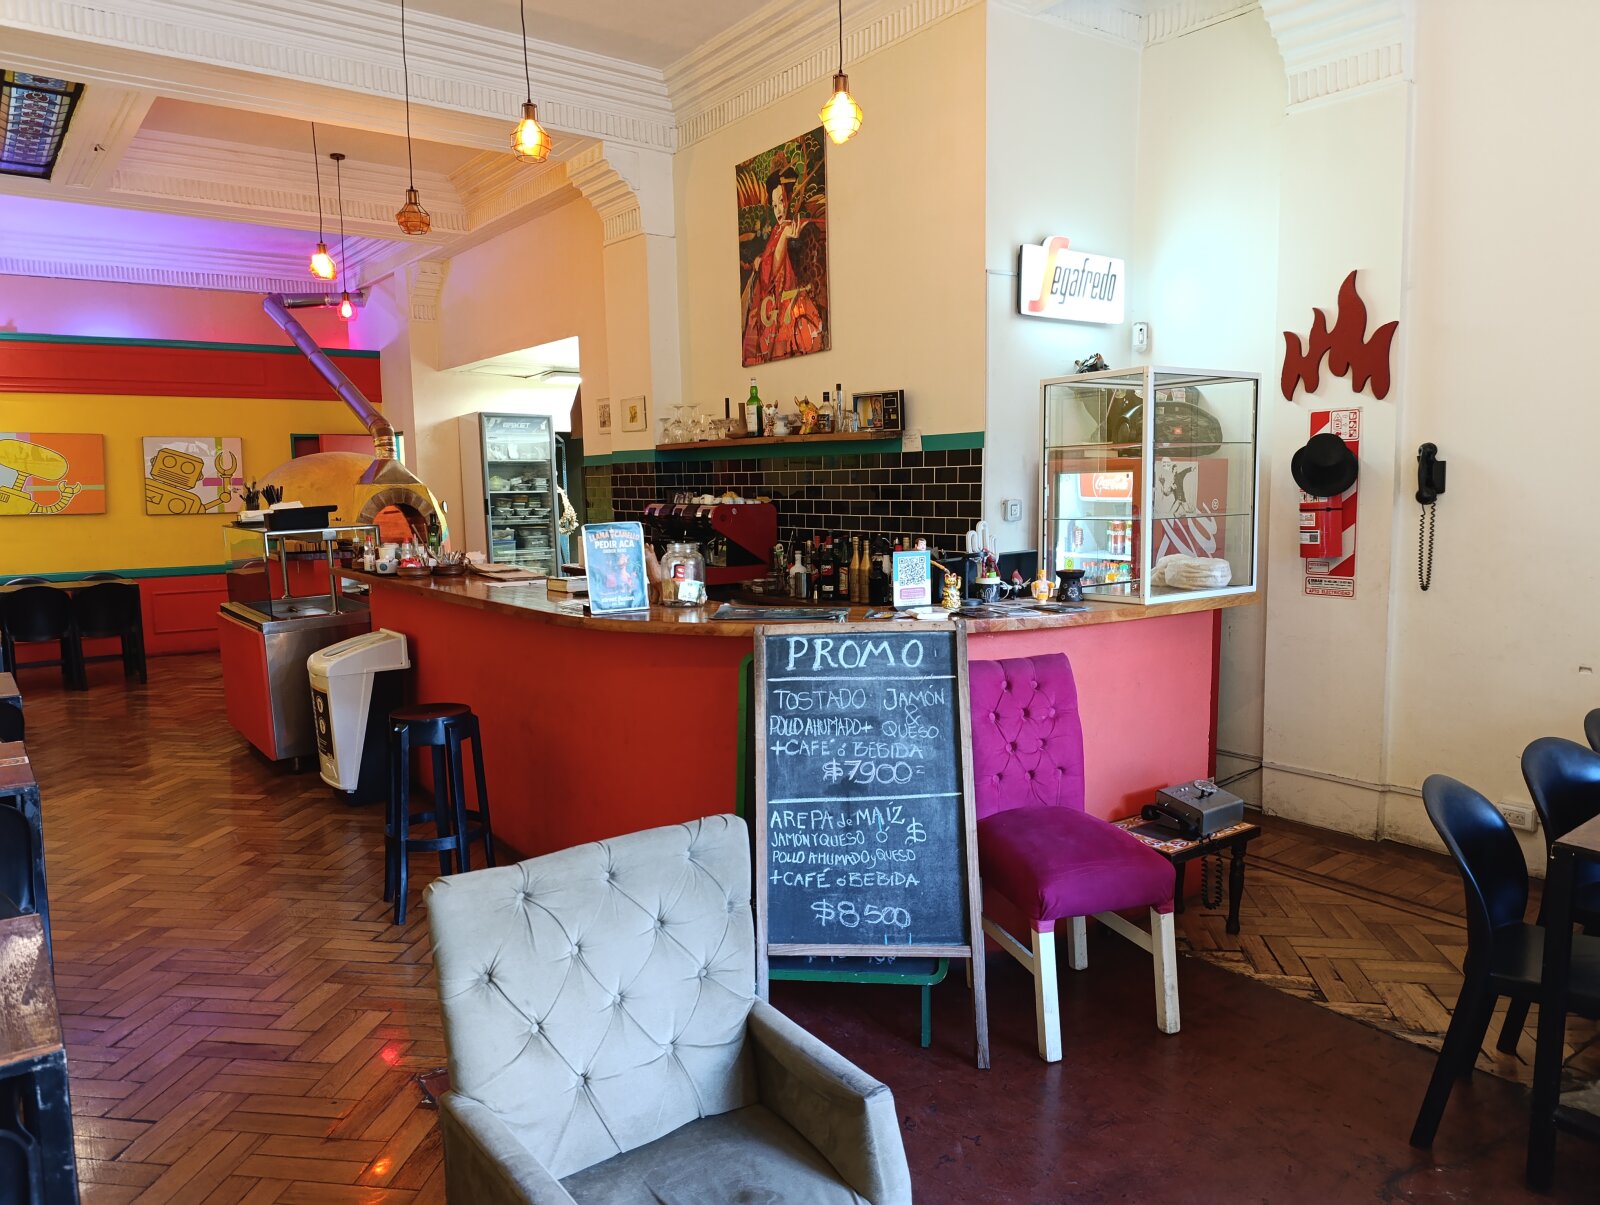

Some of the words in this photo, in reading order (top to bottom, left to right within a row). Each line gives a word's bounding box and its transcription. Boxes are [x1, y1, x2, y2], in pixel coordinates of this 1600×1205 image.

[595, 540, 617, 549] PEDIR
[785, 636, 924, 671] PROMO
[773, 688, 867, 710] TOSTADO
[883, 684, 945, 711] JAMÓN
[881, 720, 939, 739] QUESO
[853, 741, 924, 759] BEBIDA
[770, 809, 834, 830] AREPA
[836, 815, 853, 828] de
[819, 830, 865, 848] QUESO
[772, 850, 805, 864] POLLO
[807, 850, 870, 867] AHUMADO
[876, 848, 916, 863] QUESO
